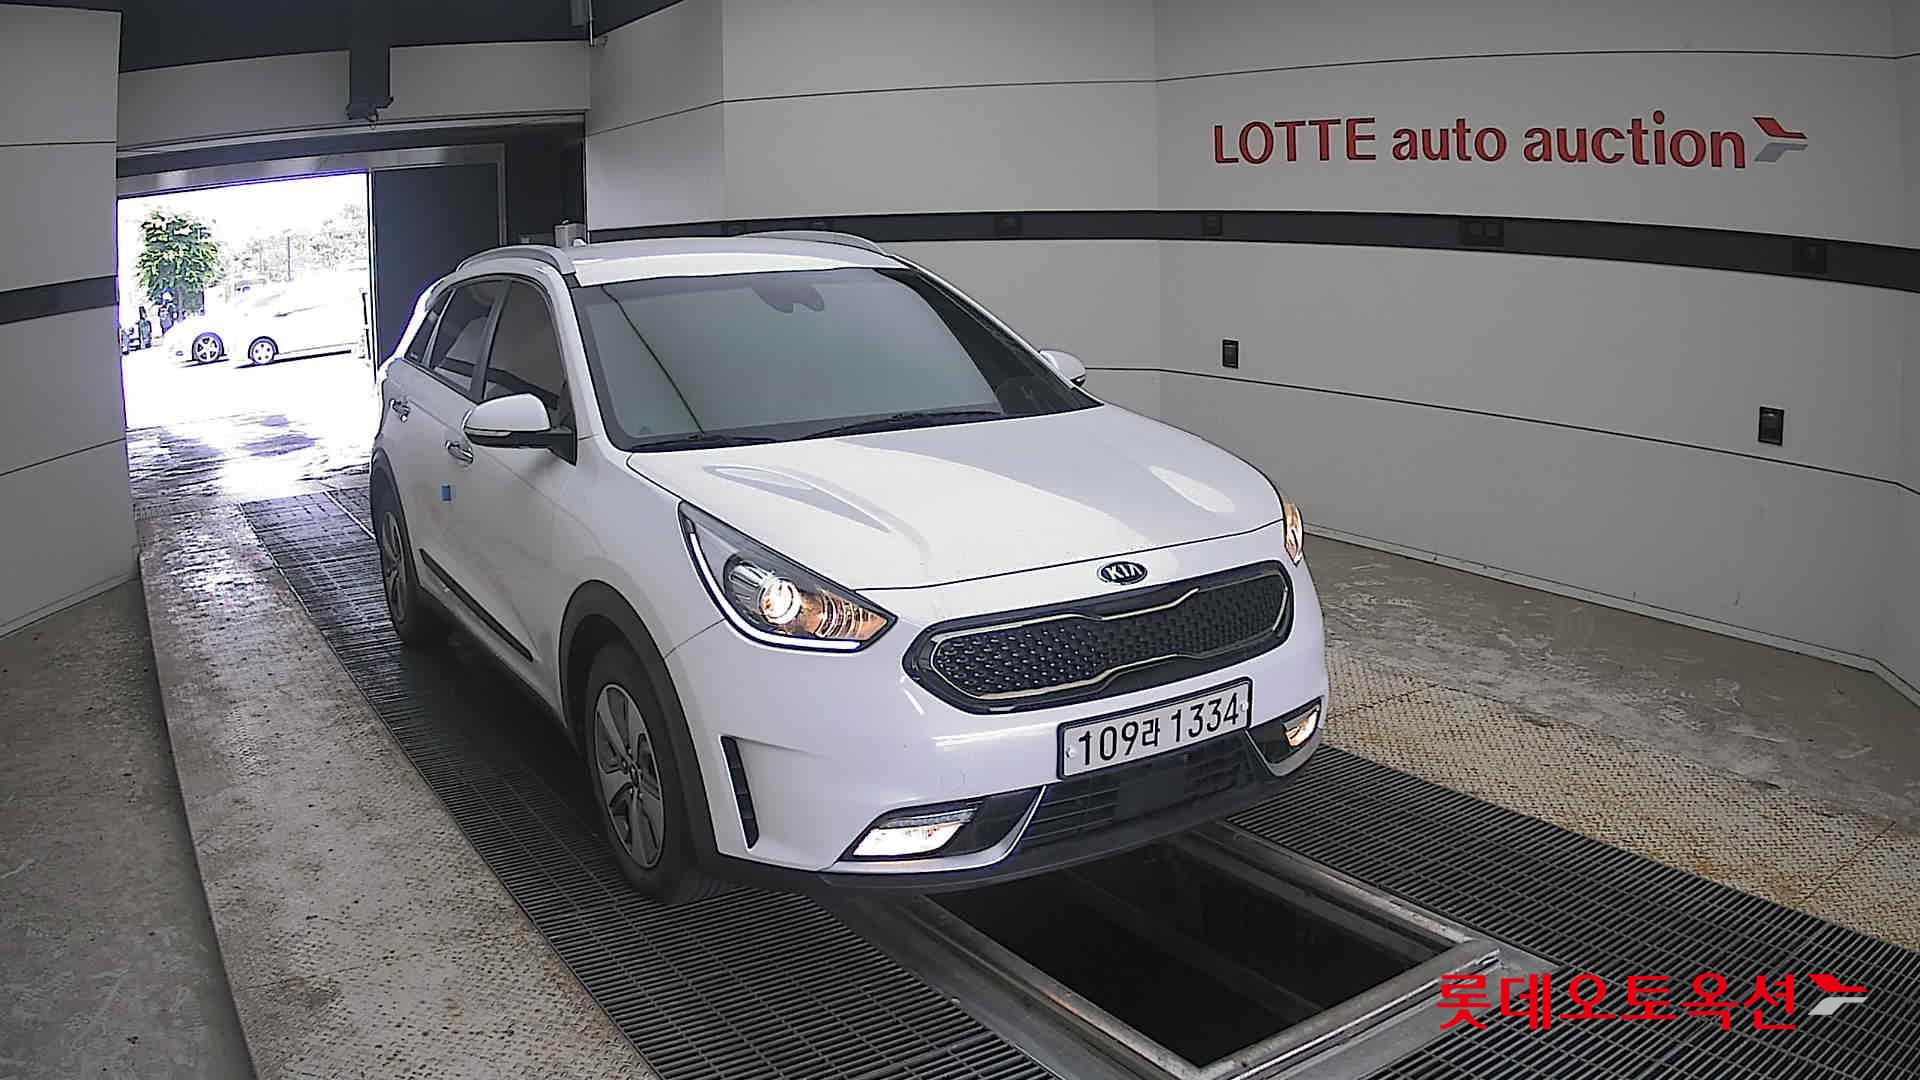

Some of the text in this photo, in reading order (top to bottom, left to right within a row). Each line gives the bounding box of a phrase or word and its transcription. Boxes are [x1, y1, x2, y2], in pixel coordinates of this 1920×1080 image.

[1213, 109, 1746, 169] LOTTE auto auction
[1106, 563, 1144, 581] KIA
[1078, 692, 1240, 766] 109라 1334
